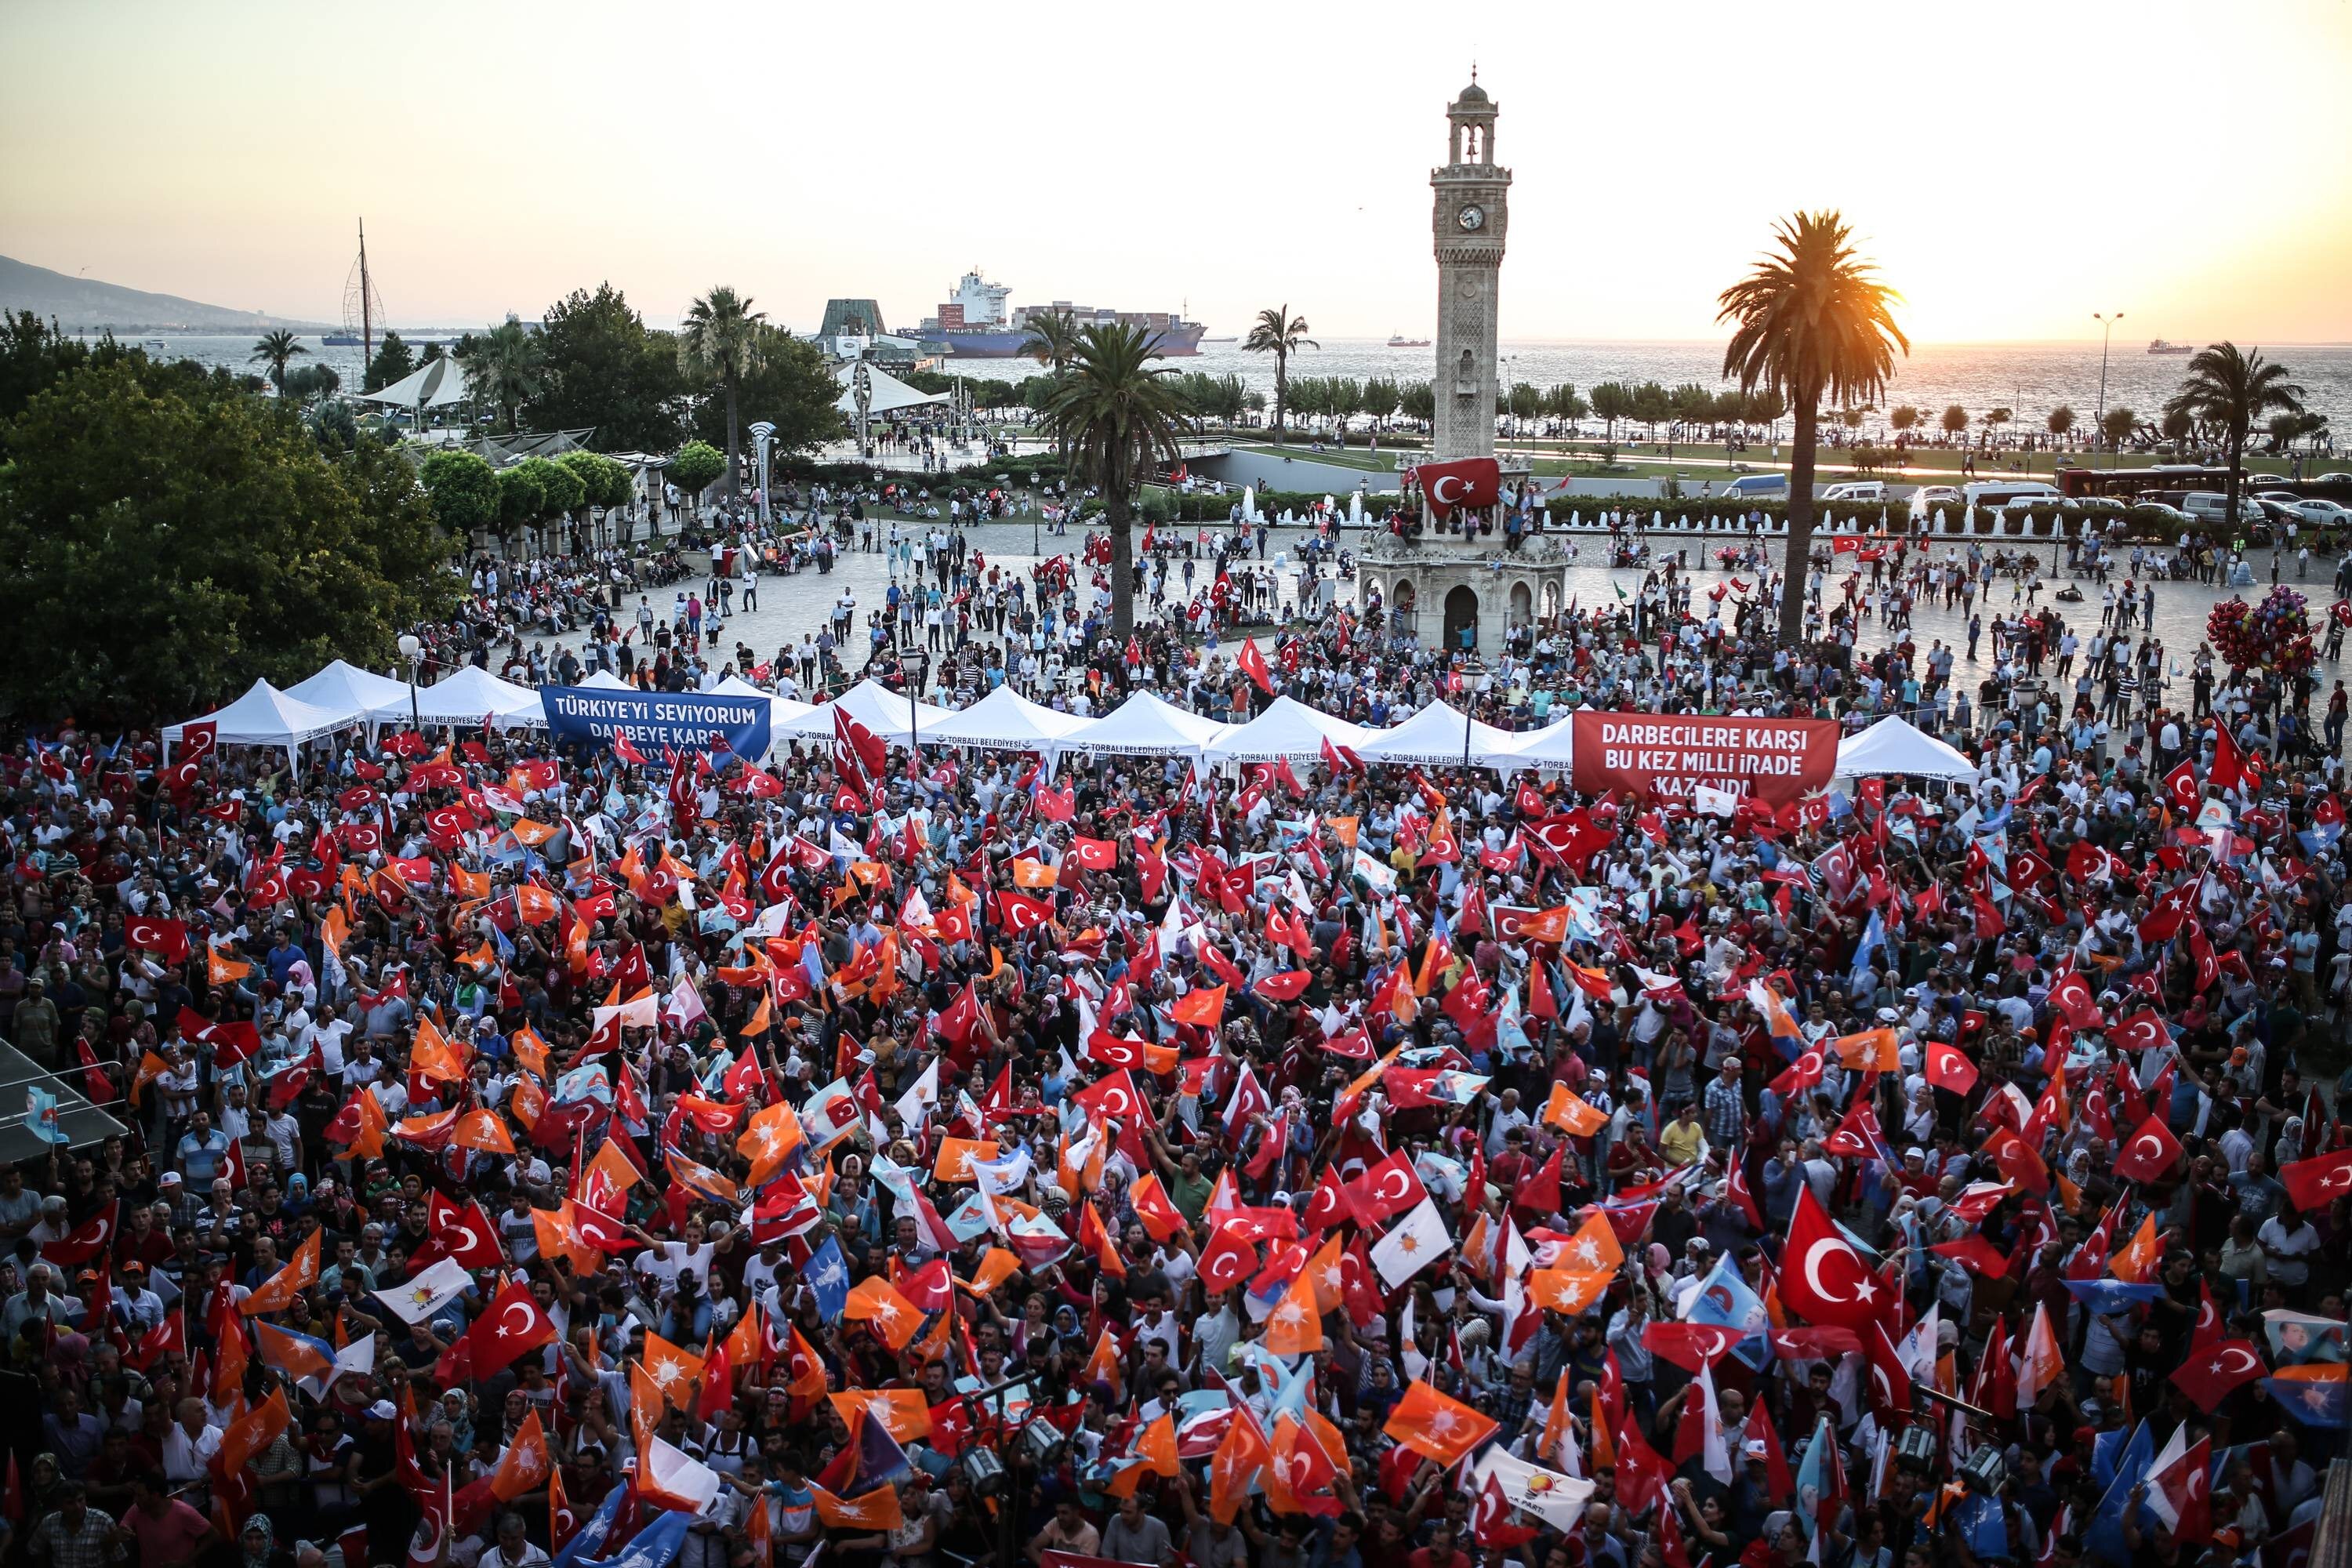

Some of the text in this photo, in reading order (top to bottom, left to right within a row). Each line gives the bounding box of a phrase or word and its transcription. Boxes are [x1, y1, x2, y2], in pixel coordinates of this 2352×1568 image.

[435, 716, 473, 724] BELEDİYESİ
[655, 704, 756, 725] SEVİYORUM
[808, 731, 836, 740] TORBAL
[1602, 724, 1807, 753] DARBECİLERE KARŞI
[948, 736, 1021, 748] TORBALI BELEDİYESİ
[1091, 743, 1167, 755] TORBALI BELEDİYESİ
[1393, 753, 1472, 764] TORBALI BELEDİYEİ
[1543, 760, 1573, 769] TORBAL
[1605, 749, 1802, 775] BU KEZ MİLLİ İRADE
[1656, 776, 1751, 797] KAZDI
